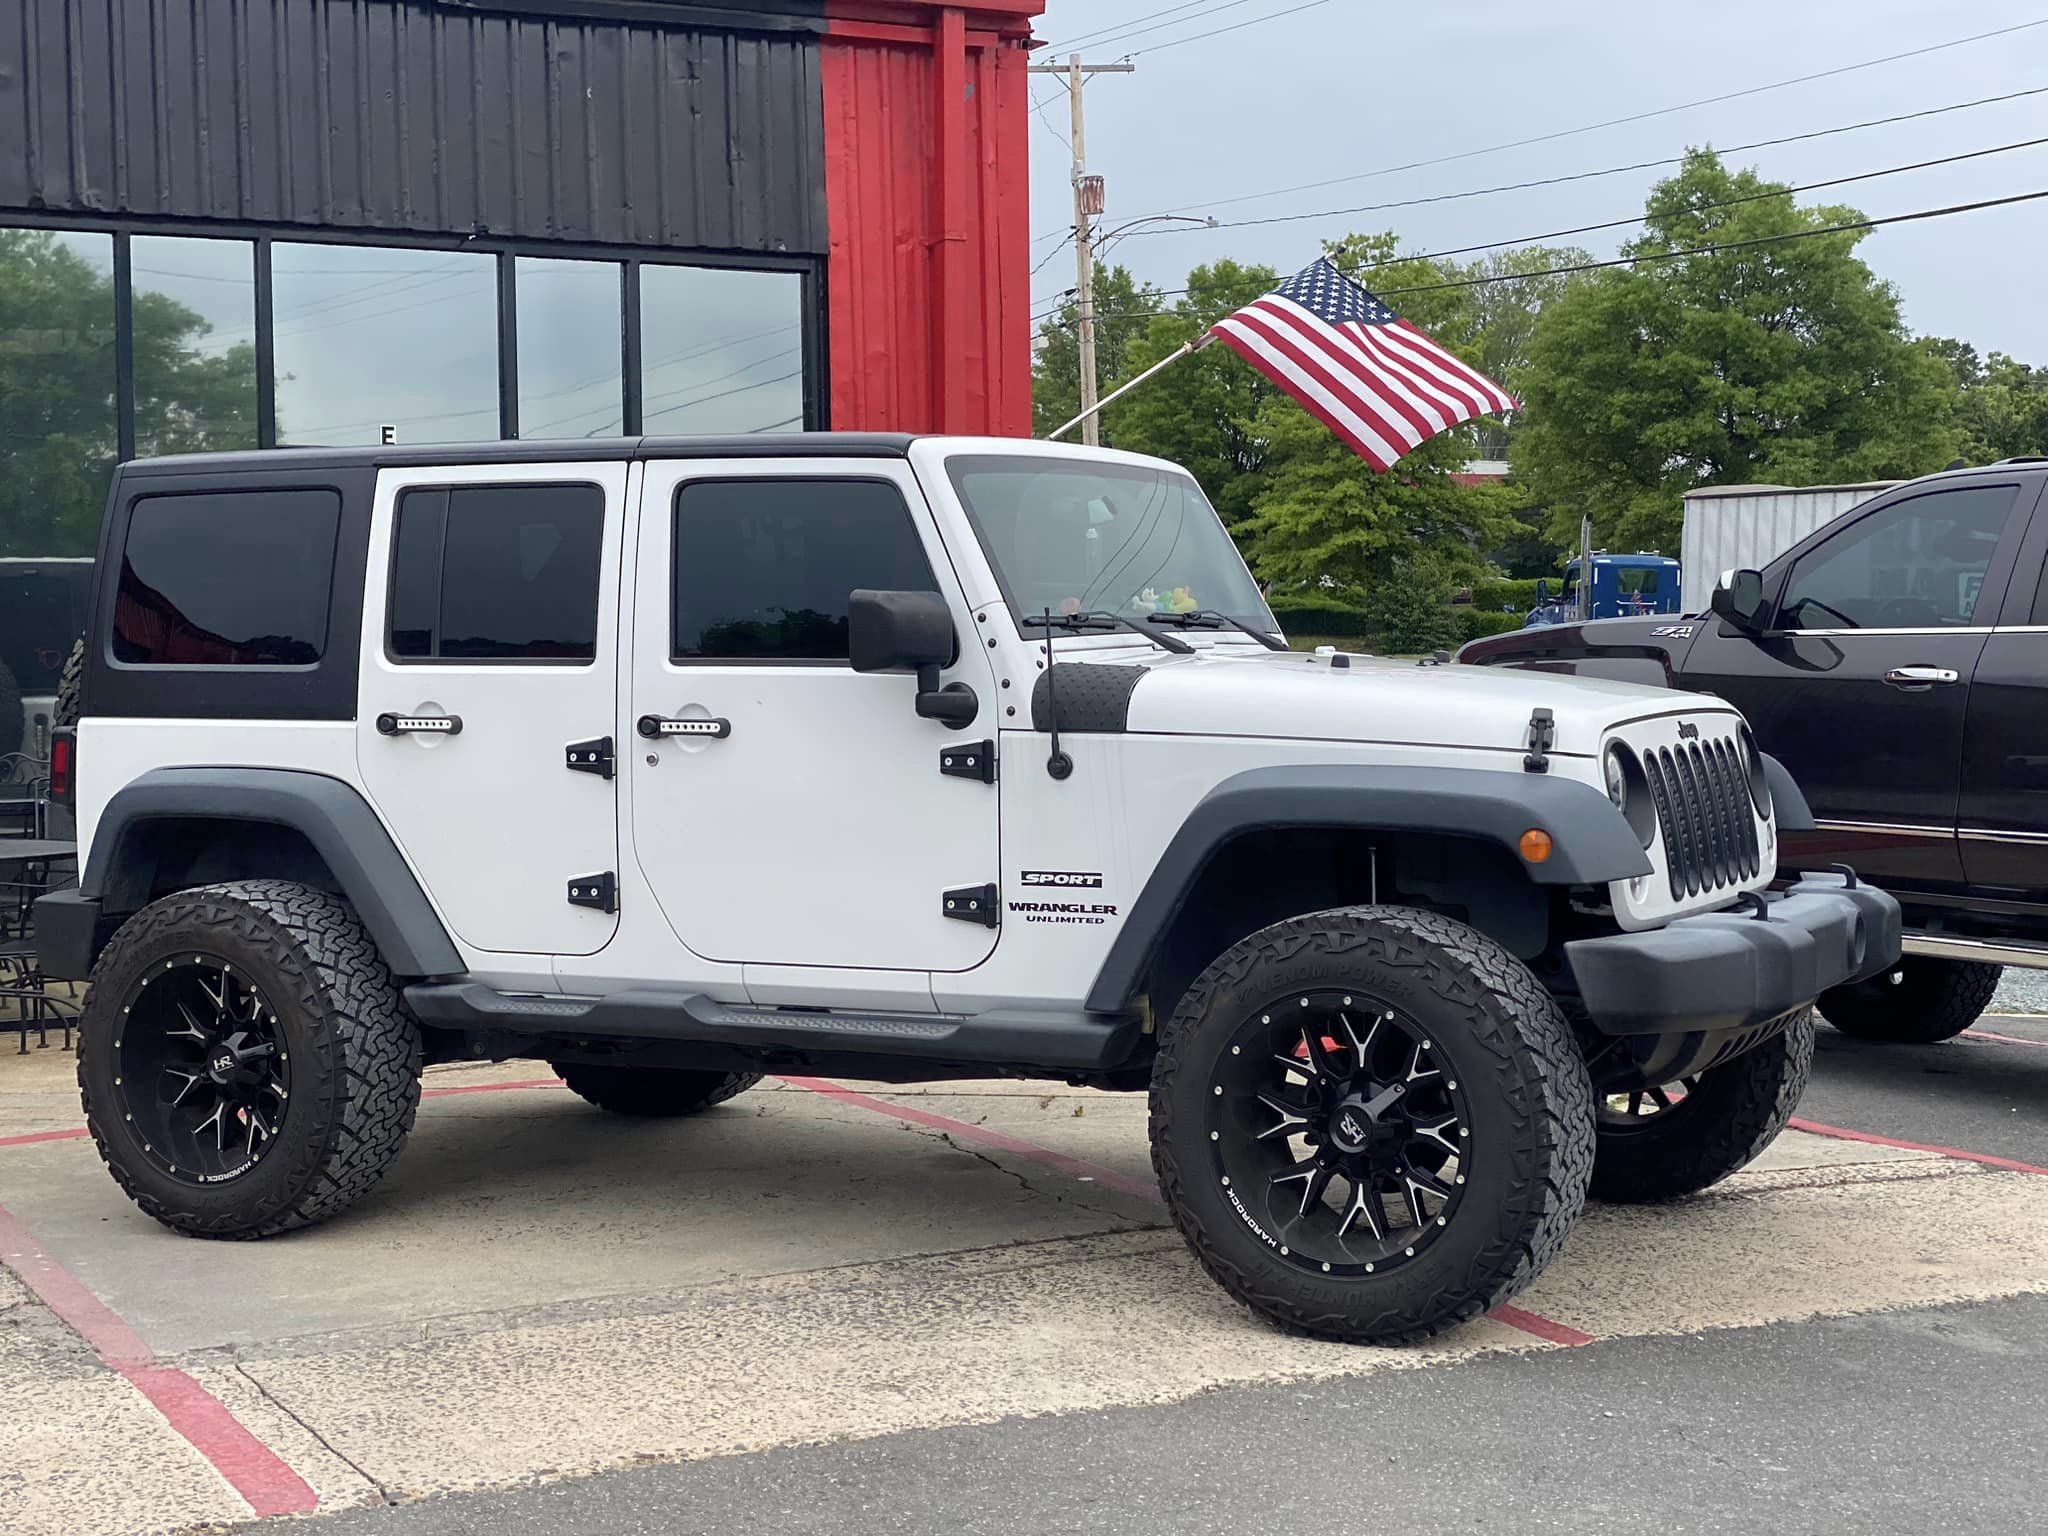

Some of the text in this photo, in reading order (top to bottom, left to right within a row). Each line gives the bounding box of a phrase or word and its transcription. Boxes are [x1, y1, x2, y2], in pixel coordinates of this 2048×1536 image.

[381, 426, 395, 446] E
[1678, 720, 1699, 741] Jeep
[1023, 872, 1102, 887] SPORT
[1008, 902, 1118, 915] WRANGLER
[1026, 915, 1105, 925] UNLIMITED
[1226, 1187, 1277, 1248] HARDROCK
